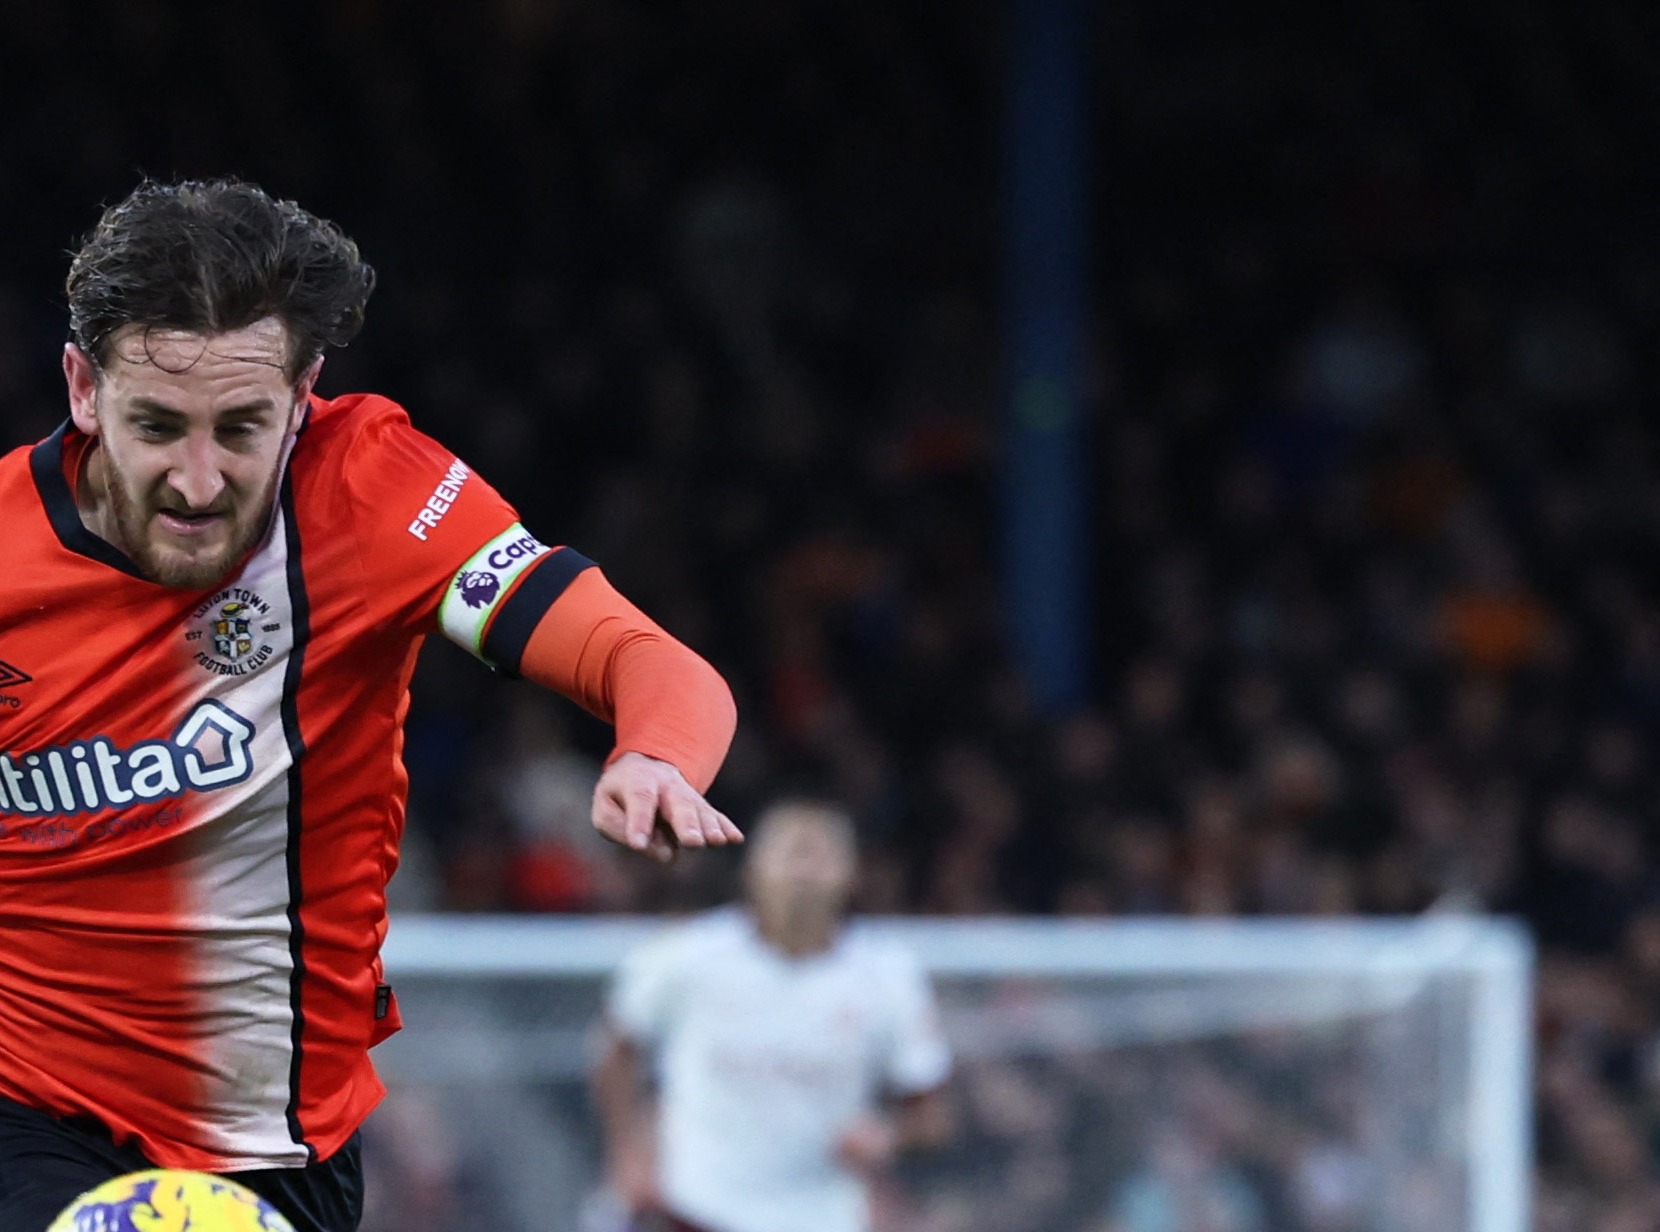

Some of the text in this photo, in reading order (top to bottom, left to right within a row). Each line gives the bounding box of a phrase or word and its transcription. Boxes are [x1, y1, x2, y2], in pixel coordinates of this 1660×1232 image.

[193, 588, 271, 619] LUTON TOWN
[193, 645, 273, 675] FOOTBALL CLUB
